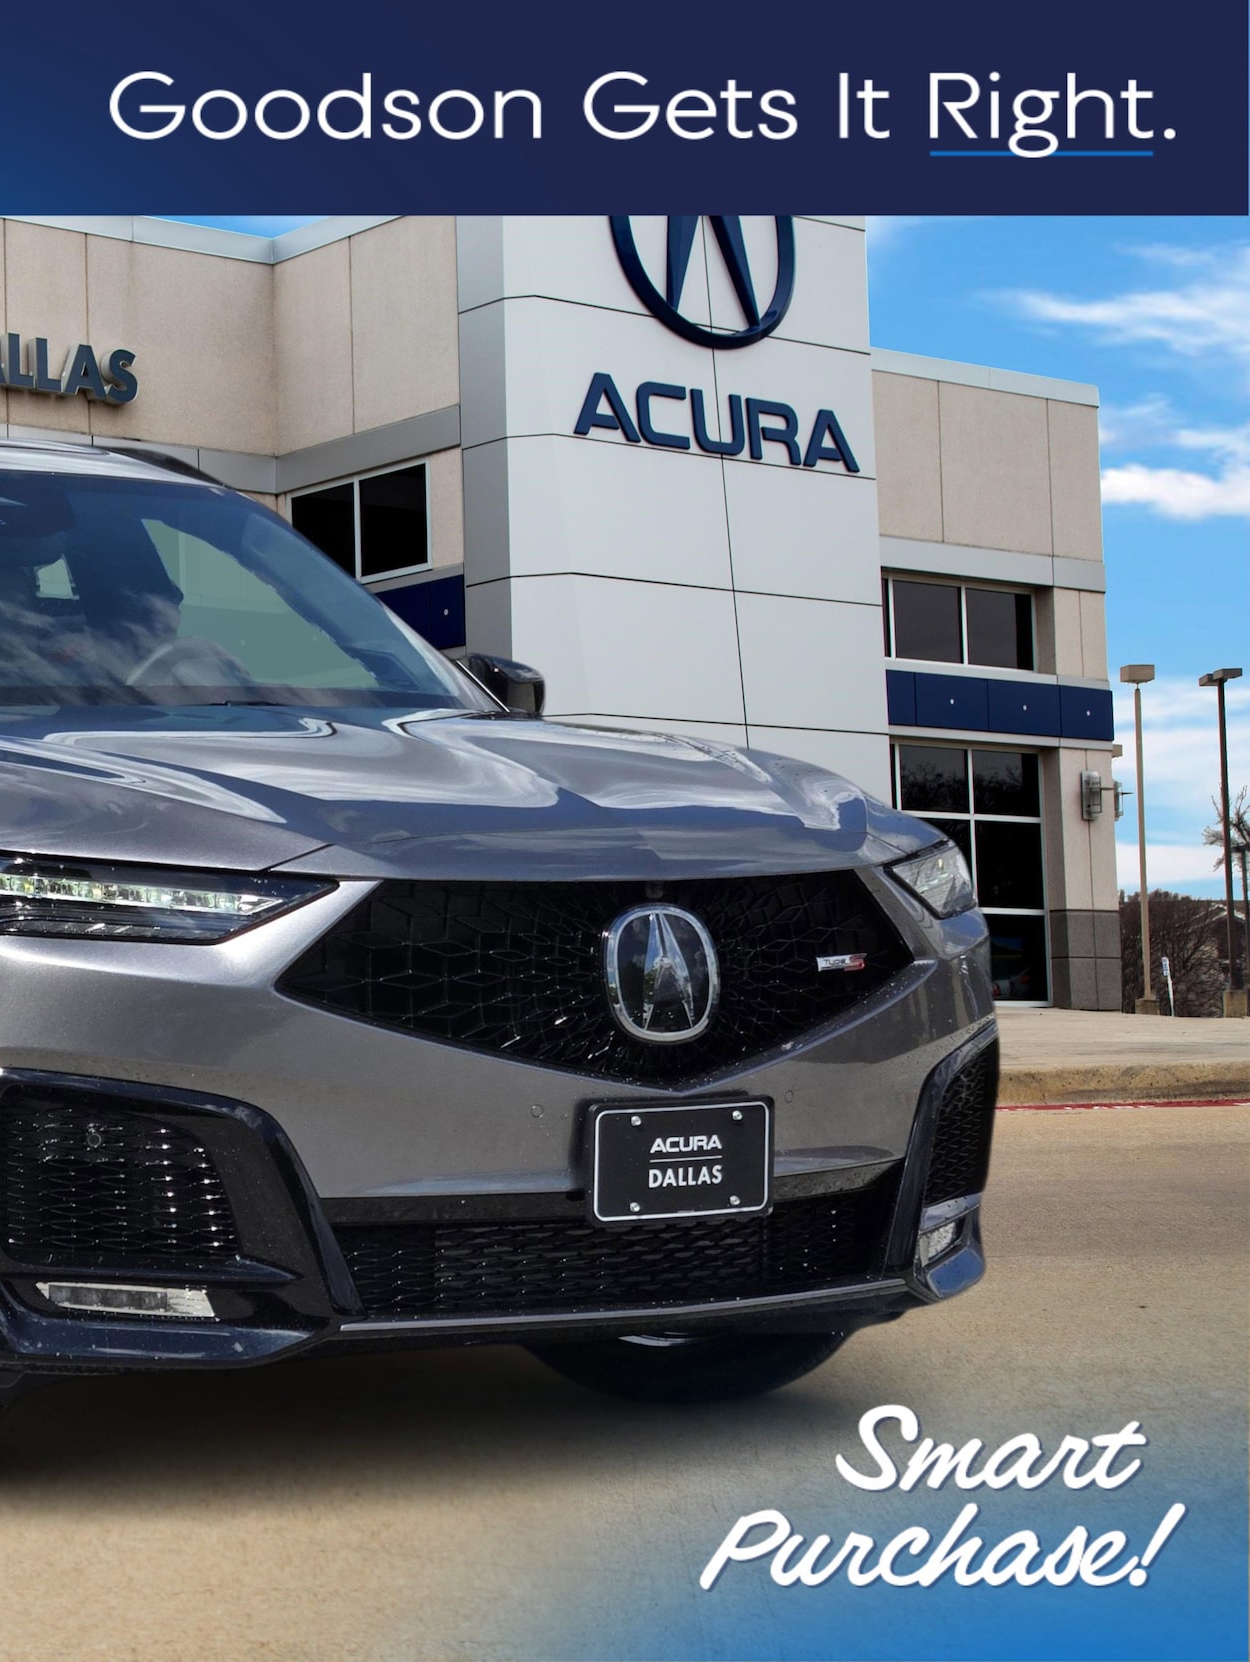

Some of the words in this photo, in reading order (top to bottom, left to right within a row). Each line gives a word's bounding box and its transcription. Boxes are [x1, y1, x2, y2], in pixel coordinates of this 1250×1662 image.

[573, 372, 860, 473] ACURA
[650, 1135, 722, 1153] ACURA
[649, 1165, 722, 1188] DALLAS
